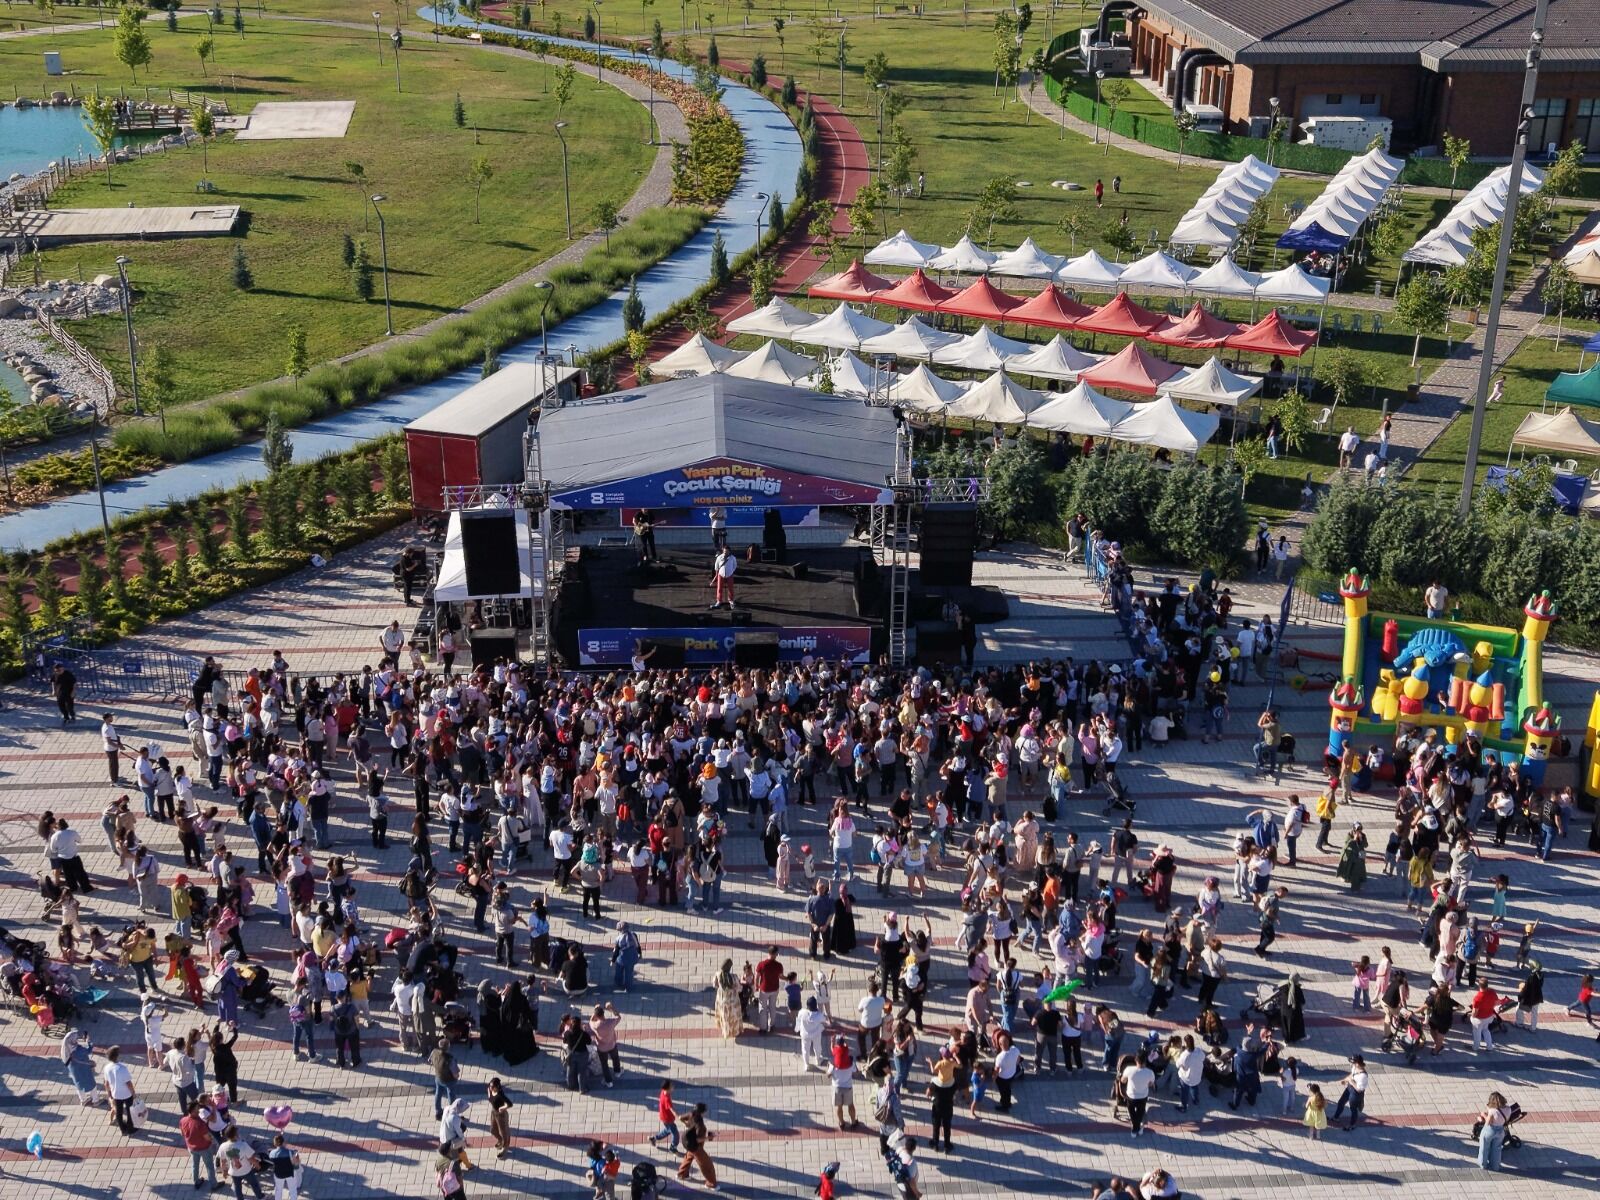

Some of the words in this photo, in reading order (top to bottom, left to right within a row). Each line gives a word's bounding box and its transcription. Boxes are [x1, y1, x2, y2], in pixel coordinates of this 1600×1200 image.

[682, 466, 731, 479] Yaşam
[731, 464, 766, 477] Park
[663, 476, 720, 497] Çocuk
[721, 475, 781, 496] Şenliği
[684, 637, 719, 651] Park
[776, 635, 817, 651] enliği
[558, 746, 568, 757] 26
